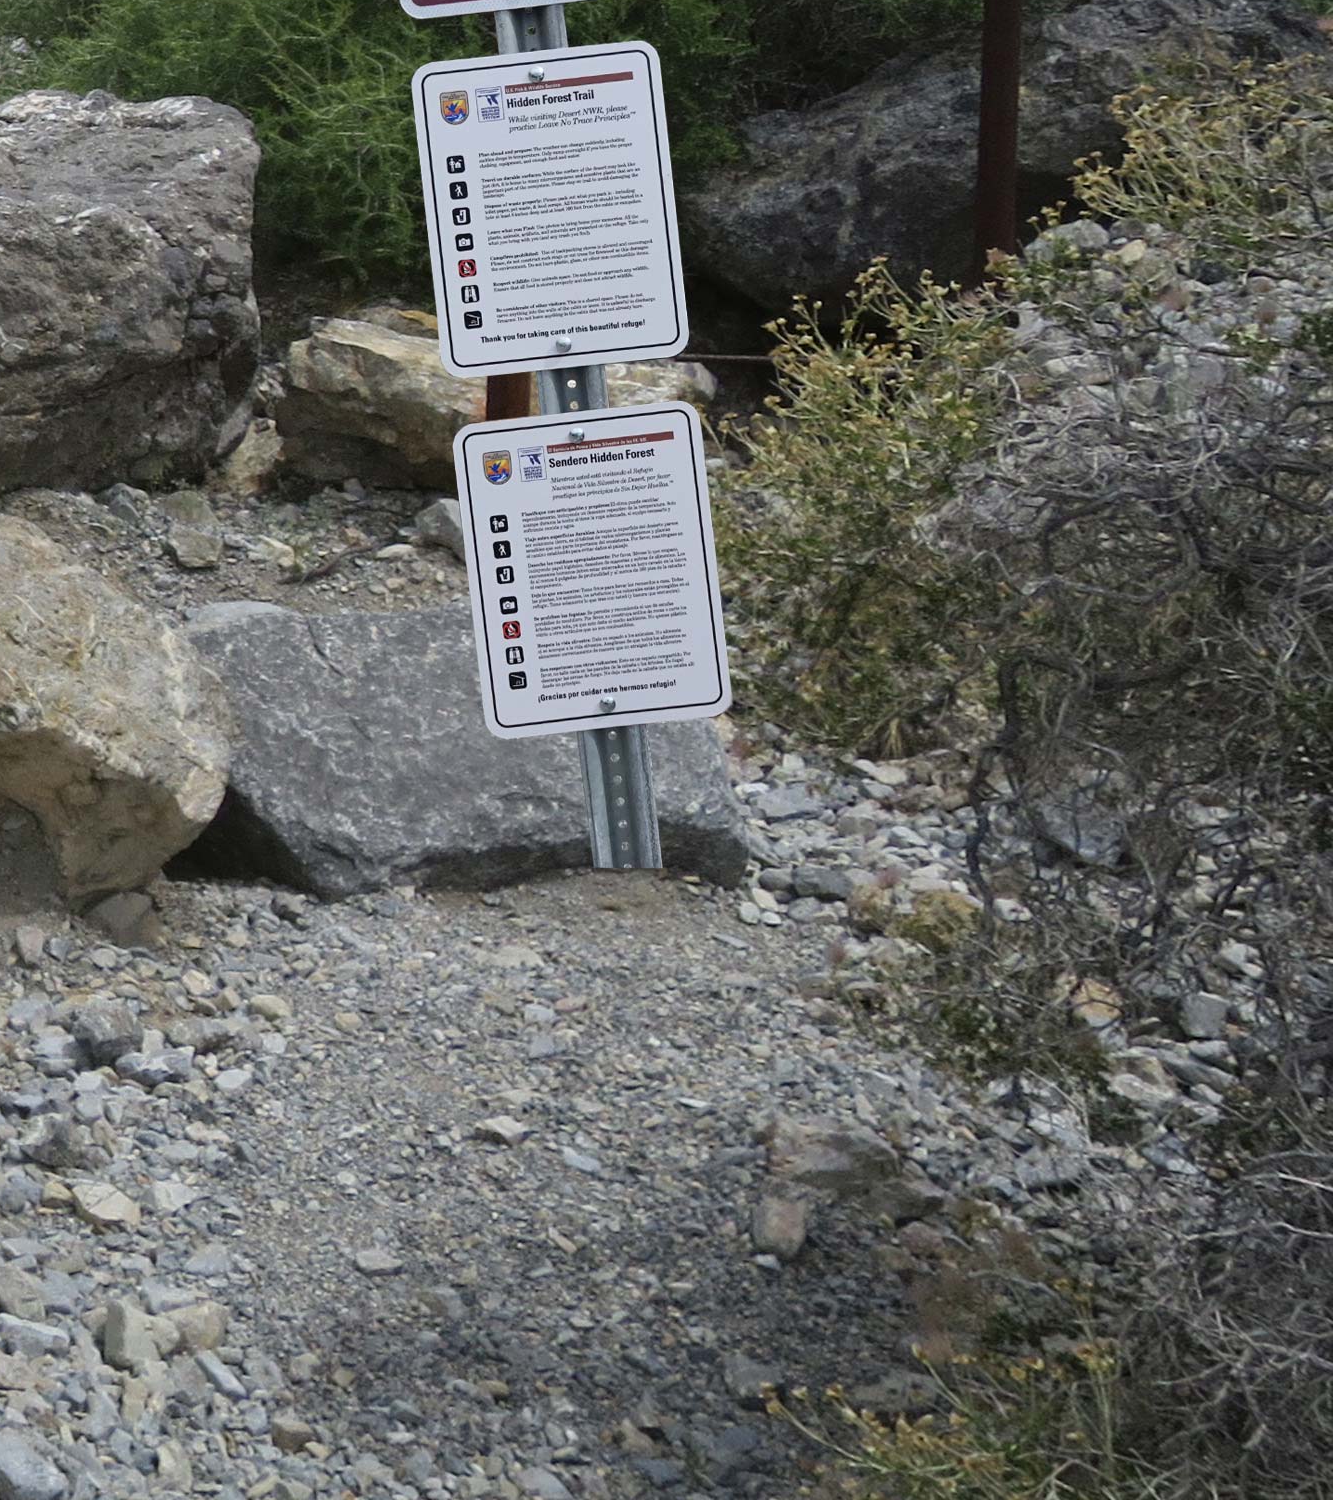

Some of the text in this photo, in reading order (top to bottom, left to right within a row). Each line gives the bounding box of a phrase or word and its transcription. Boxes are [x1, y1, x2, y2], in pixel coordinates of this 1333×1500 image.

[506, 89, 595, 109] Hidden Forest Trail
[508, 114, 529, 124] While
[530, 112, 557, 122] visiting
[557, 109, 582, 119] Desert
[605, 104, 628, 115] please
[538, 121, 559, 129] Leave
[560, 118, 572, 127] No
[480, 318, 646, 344] Thank you for taking care of this beautiful refuge!
[548, 448, 655, 469] Sendero Hidden Forest
[537, 678, 677, 704] ¡Gracias por cuidar este hermoso refugio!
